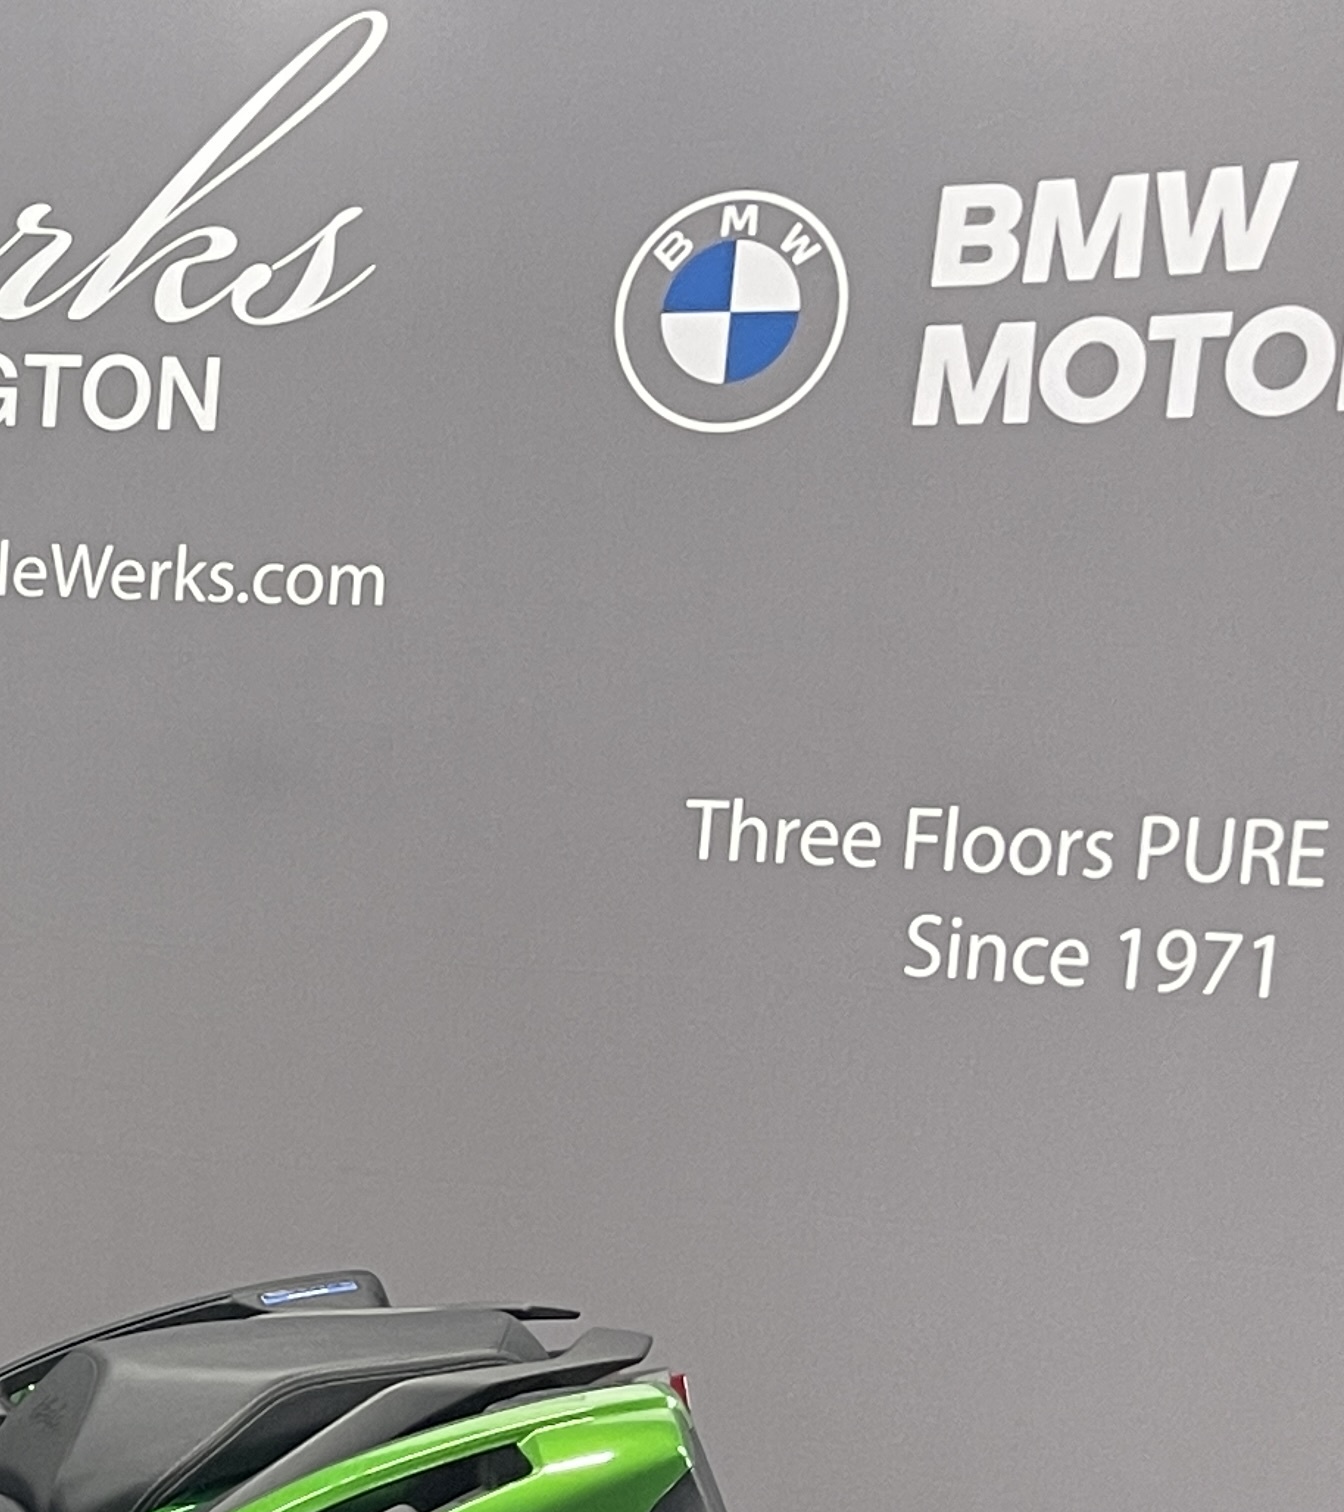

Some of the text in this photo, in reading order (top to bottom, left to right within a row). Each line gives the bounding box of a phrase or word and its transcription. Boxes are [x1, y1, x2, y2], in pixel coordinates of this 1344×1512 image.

[653, 204, 822, 272] BMW
[930, 160, 1300, 288] BMW
[912, 305, 1344, 426] MOTO
[685, 797, 1329, 888] Three Floors PURE
[903, 914, 1276, 999] Since 1971
